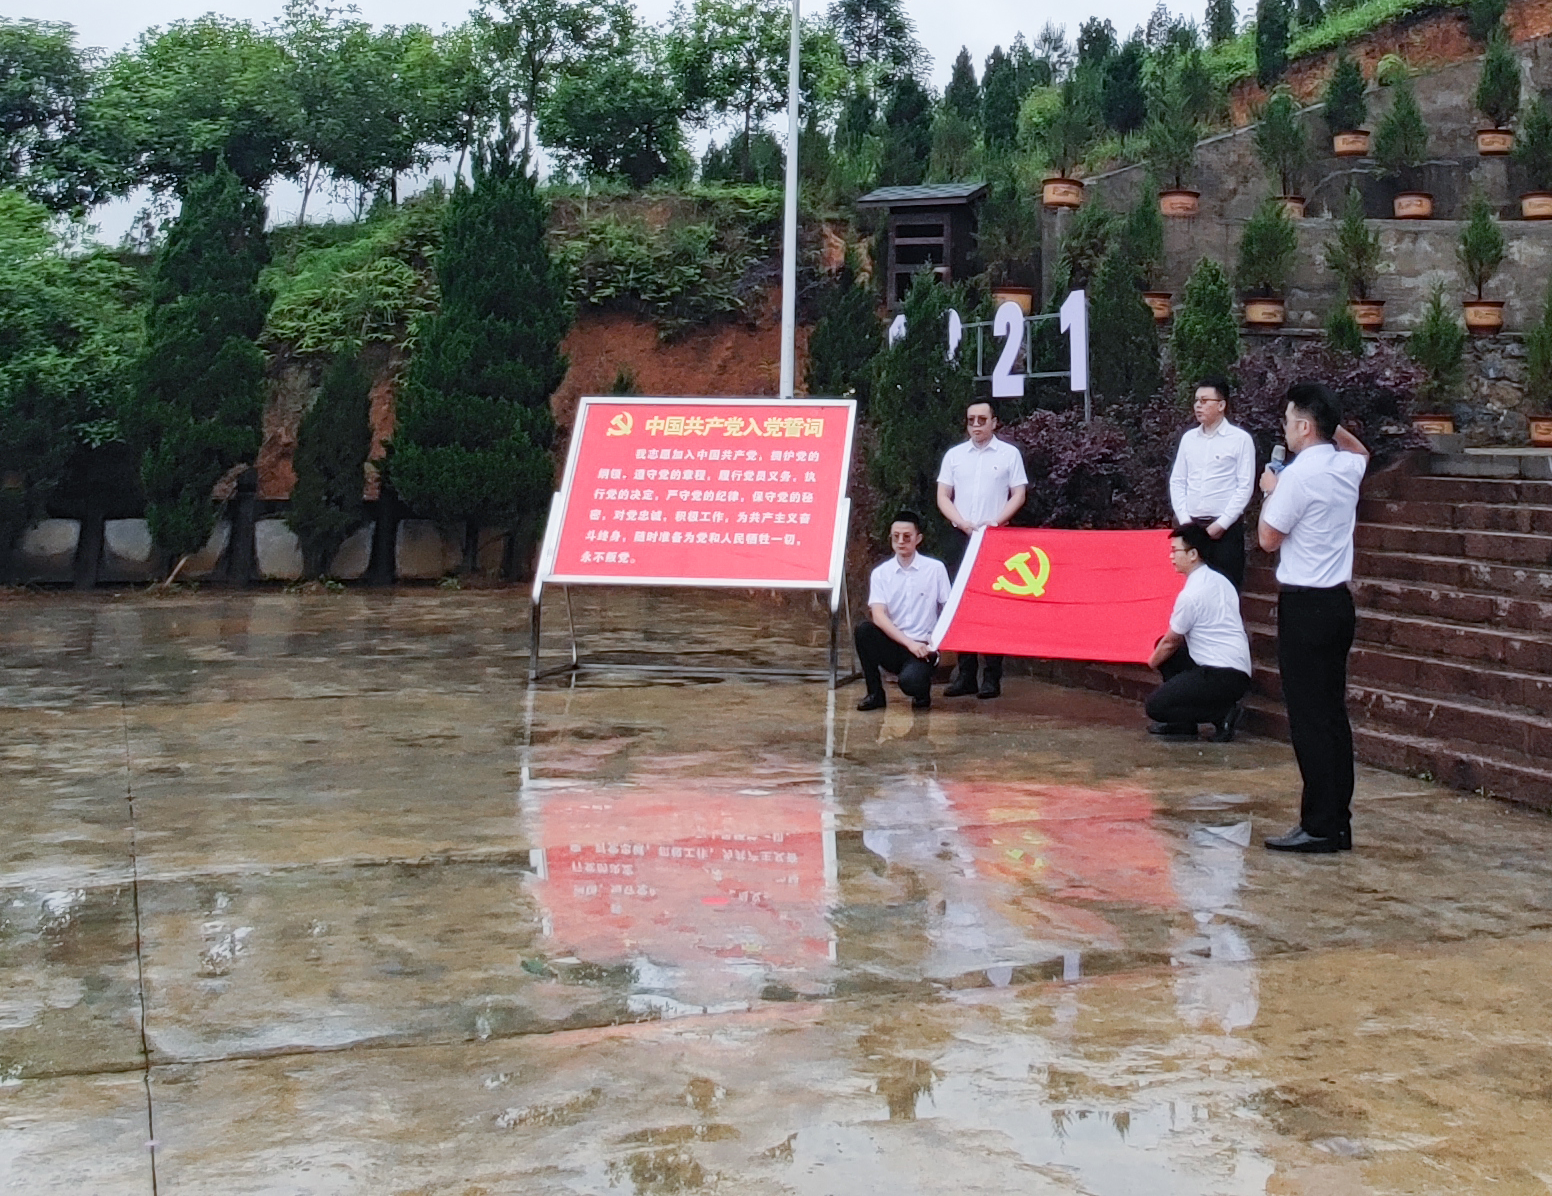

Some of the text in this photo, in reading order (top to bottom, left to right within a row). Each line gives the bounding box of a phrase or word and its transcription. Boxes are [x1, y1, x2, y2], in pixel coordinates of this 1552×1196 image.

[644, 415, 825, 438] 中国共产党入党誓词
